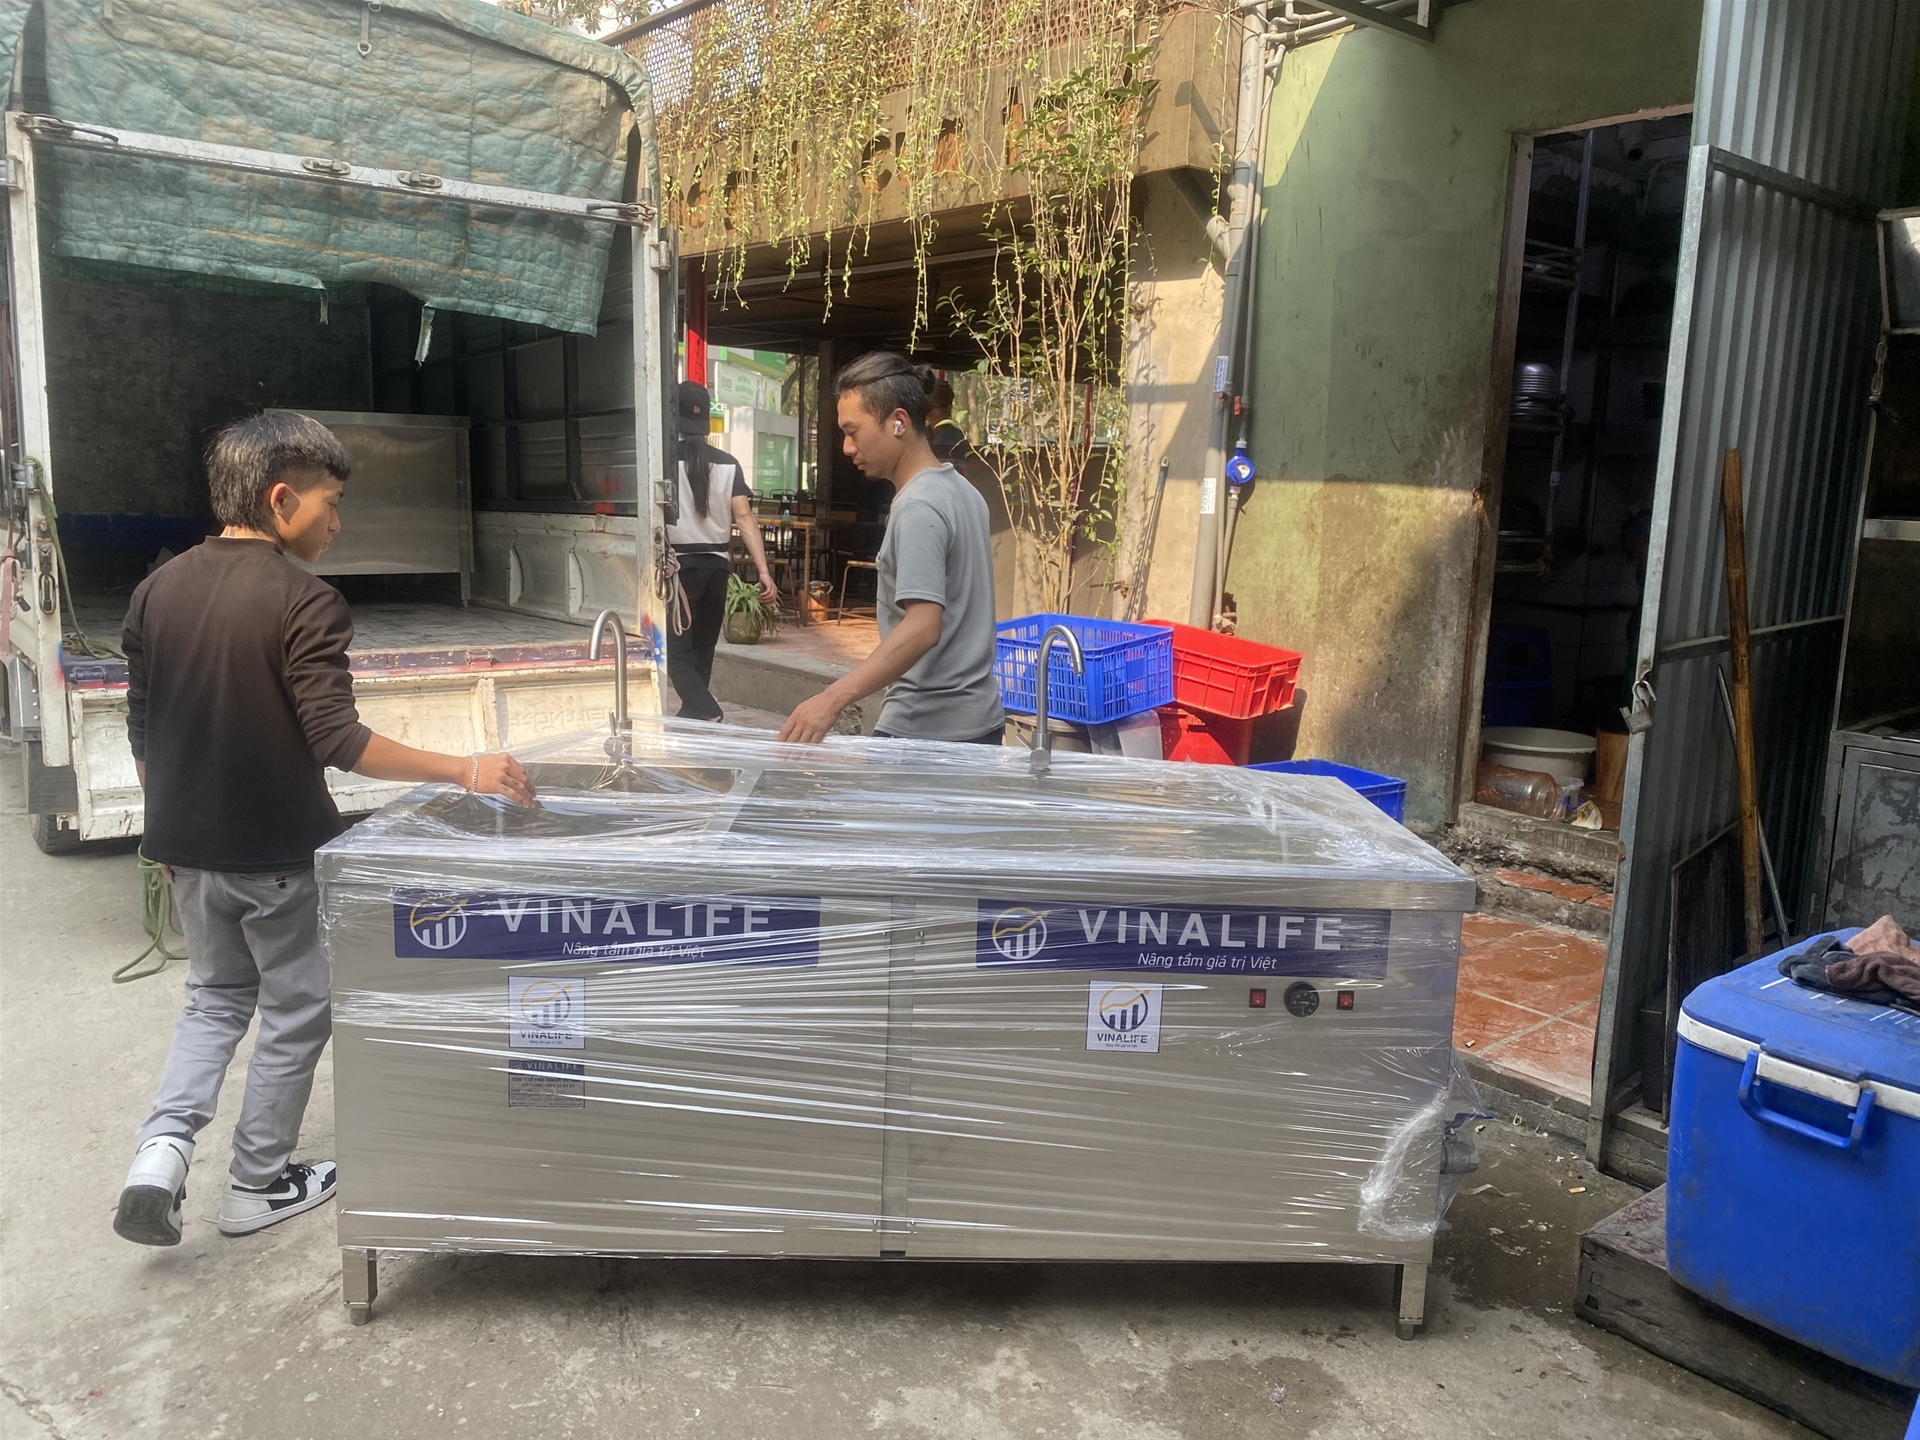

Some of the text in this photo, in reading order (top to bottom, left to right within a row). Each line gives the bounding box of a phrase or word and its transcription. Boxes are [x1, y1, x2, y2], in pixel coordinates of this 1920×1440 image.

[497, 898, 771, 938] VINALIFE
[1078, 909, 1342, 950] VINALIFE
[562, 941, 599, 957] Nâng
[1138, 951, 1277, 971] Nâng tầm giá trị Việt
[521, 1031, 572, 1040] VINALIFE
[1097, 1033, 1148, 1044] VINALIFE
[526, 1062, 579, 1070] VINALIFE
